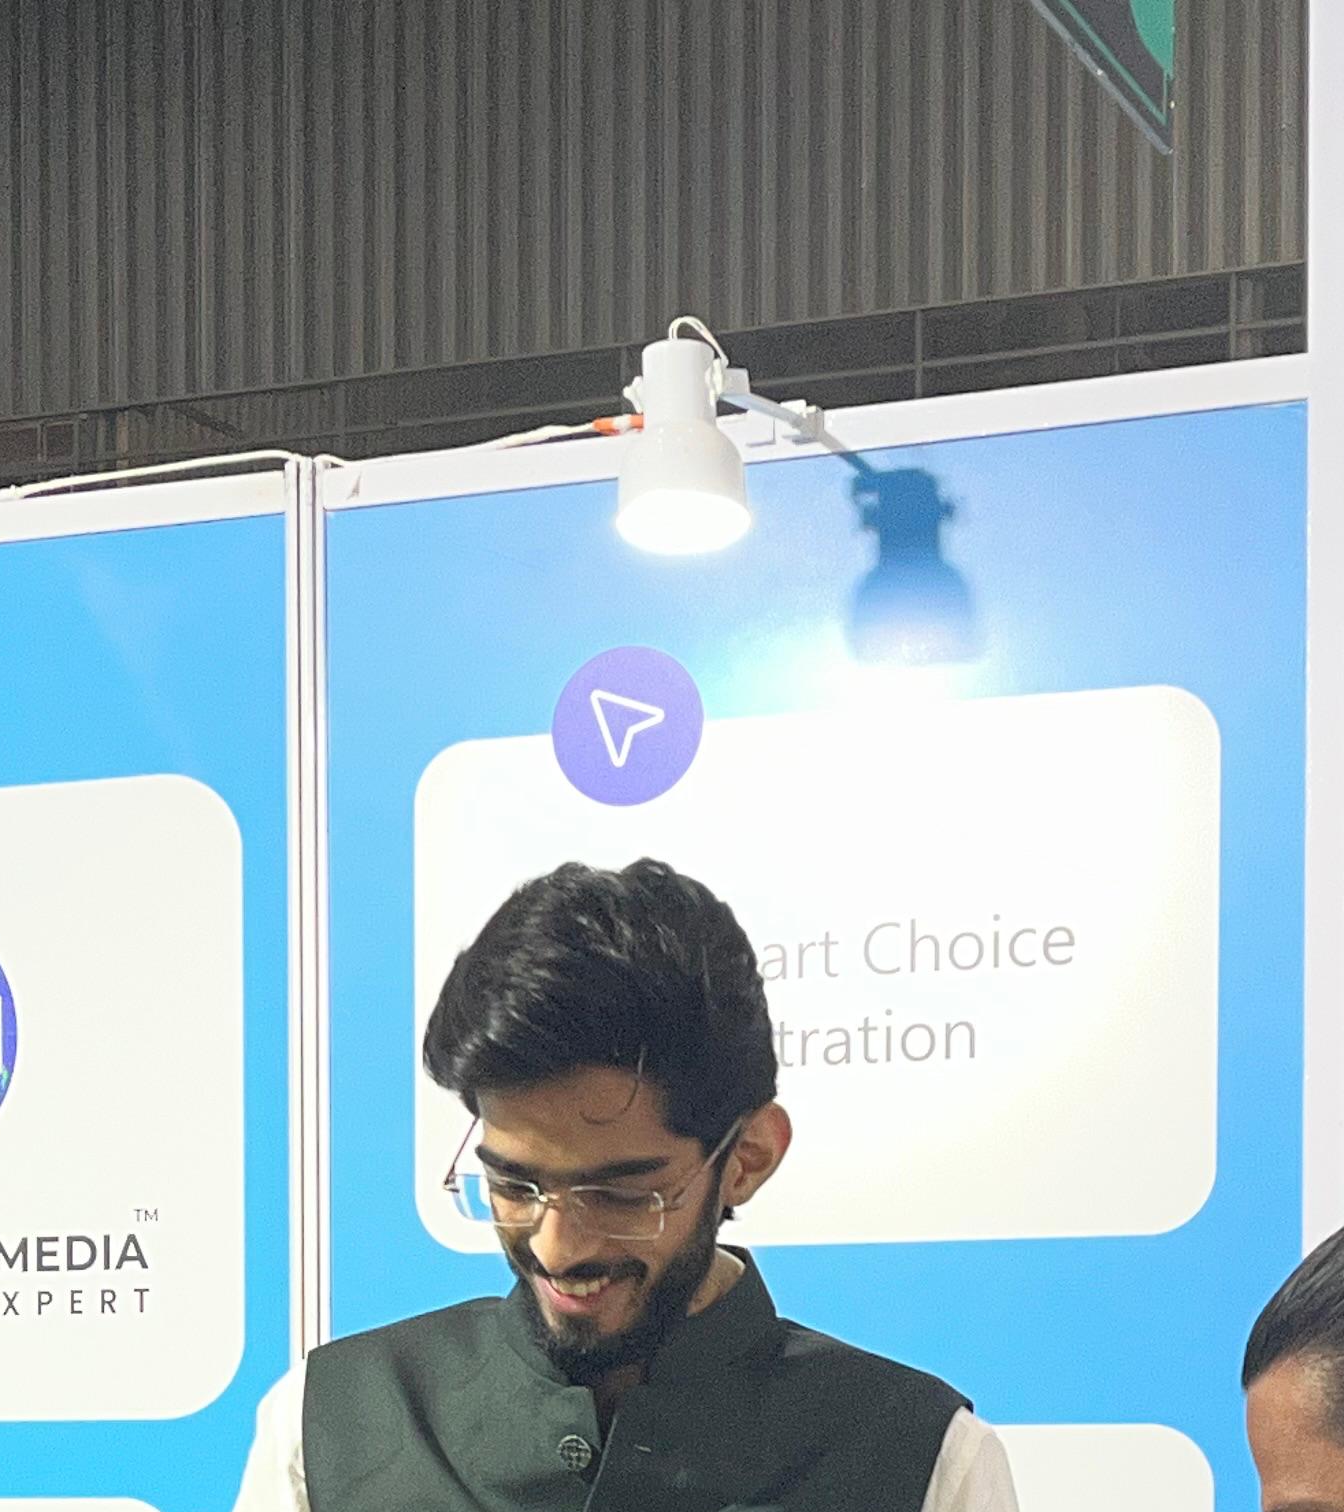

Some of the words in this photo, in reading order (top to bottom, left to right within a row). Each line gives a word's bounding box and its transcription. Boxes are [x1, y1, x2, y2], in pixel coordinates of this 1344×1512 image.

[760, 931, 840, 981] art
[863, 914, 1076, 976] Choice
[775, 1008, 976, 1067] tration
[134, 1208, 159, 1222] TM
